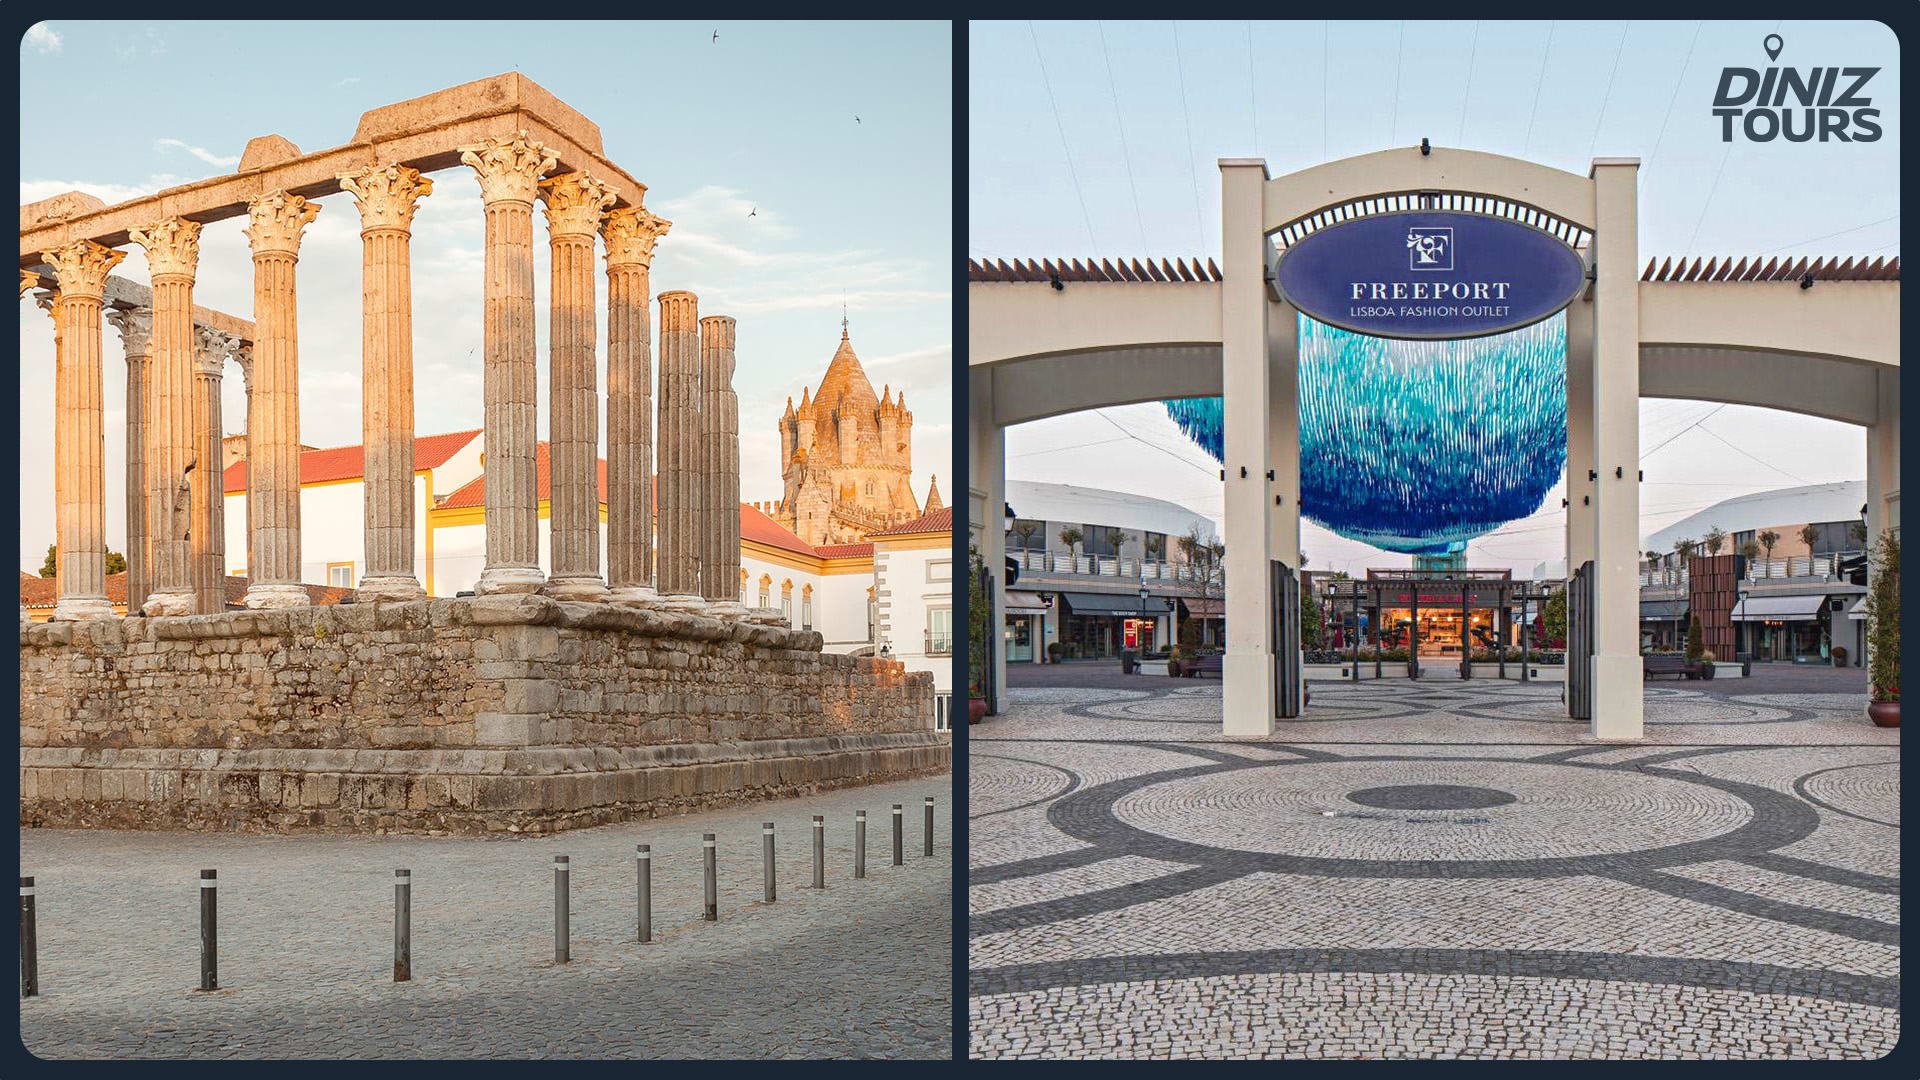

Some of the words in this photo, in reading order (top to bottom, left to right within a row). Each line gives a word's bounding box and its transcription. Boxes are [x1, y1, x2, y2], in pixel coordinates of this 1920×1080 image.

[1350, 282, 1510, 300] FREEPORT
[1350, 306, 1395, 317] LISBOA
[1400, 306, 1458, 317] FASHION
[1461, 306, 1510, 317] OUTLET
